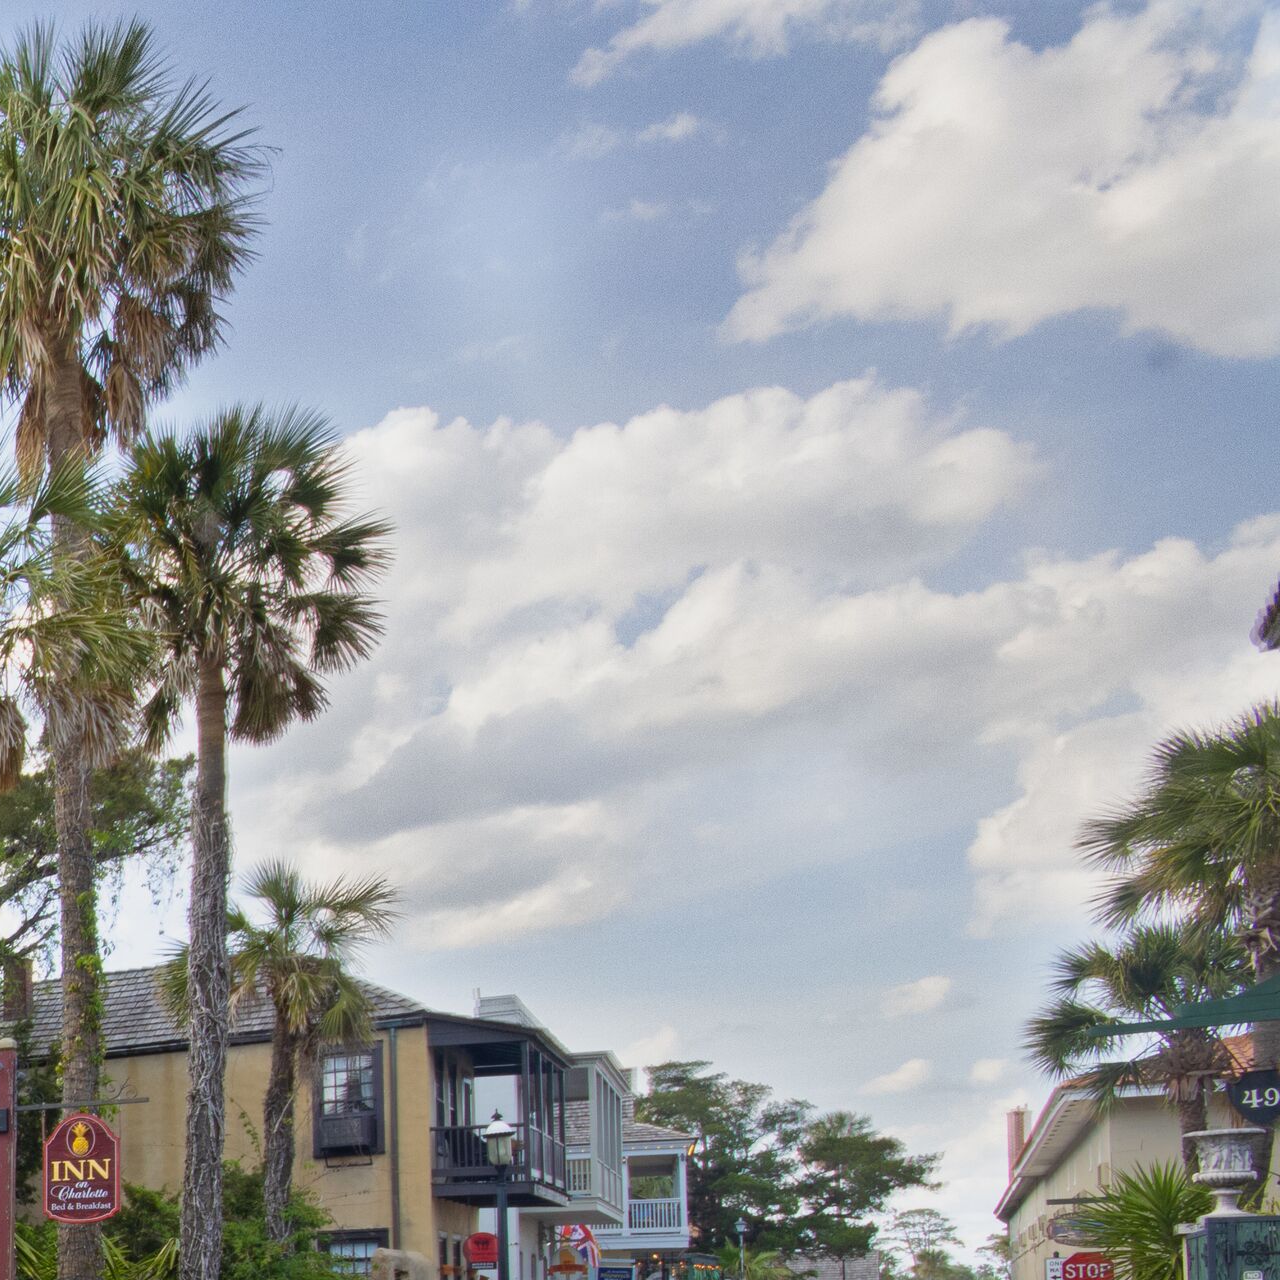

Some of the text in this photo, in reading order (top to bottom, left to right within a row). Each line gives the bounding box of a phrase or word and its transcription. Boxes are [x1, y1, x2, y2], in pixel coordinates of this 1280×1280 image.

[1242, 1087, 1280, 1108] 49
[51, 1158, 111, 1181] INN
[50, 1185, 109, 1202] Charlotte
[51, 1203, 66, 1211] Bed
[76, 1202, 111, 1210] Breakfast
[1065, 1263, 1111, 1279] STOP
